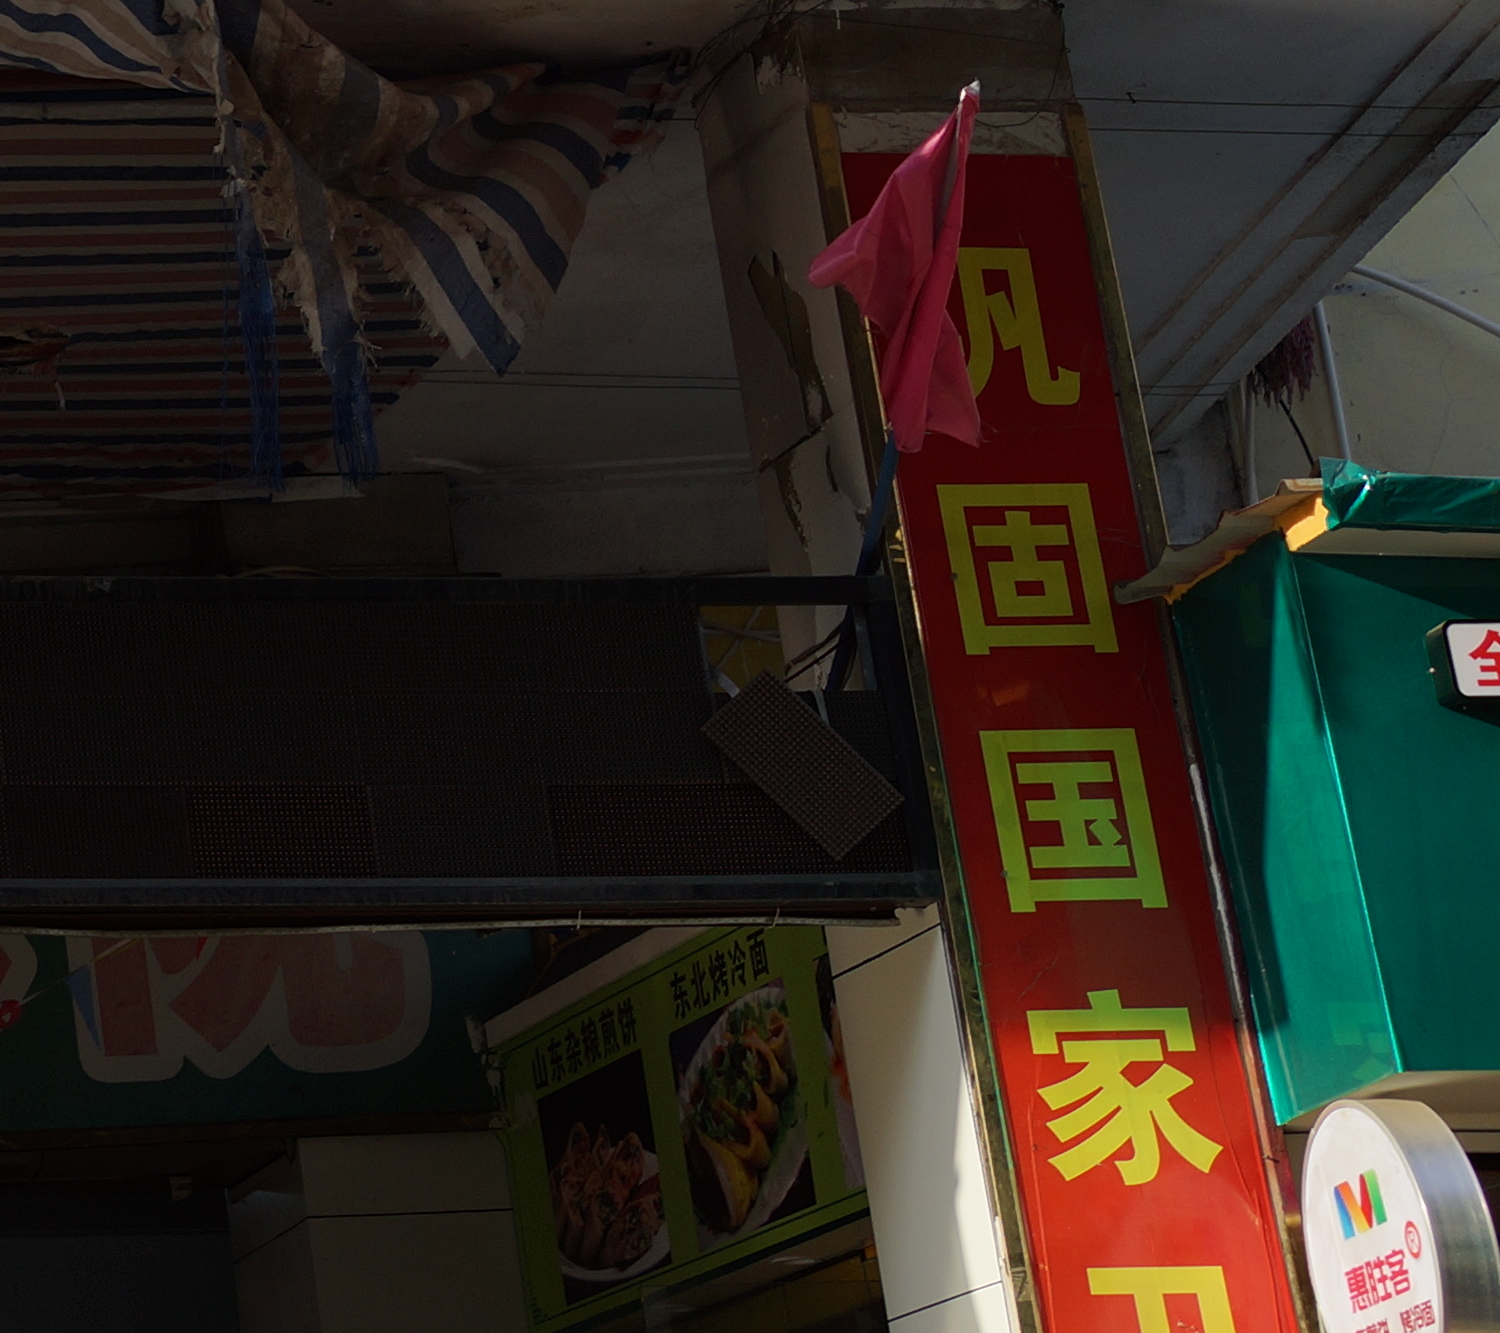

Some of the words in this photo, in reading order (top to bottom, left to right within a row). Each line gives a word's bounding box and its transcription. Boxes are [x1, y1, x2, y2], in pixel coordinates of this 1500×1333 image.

[669, 927, 770, 1021] 东北烤冷面
[531, 997, 638, 1090] 山东杂粮煎饼
[1344, 1249, 1411, 1313] 惠胜客
